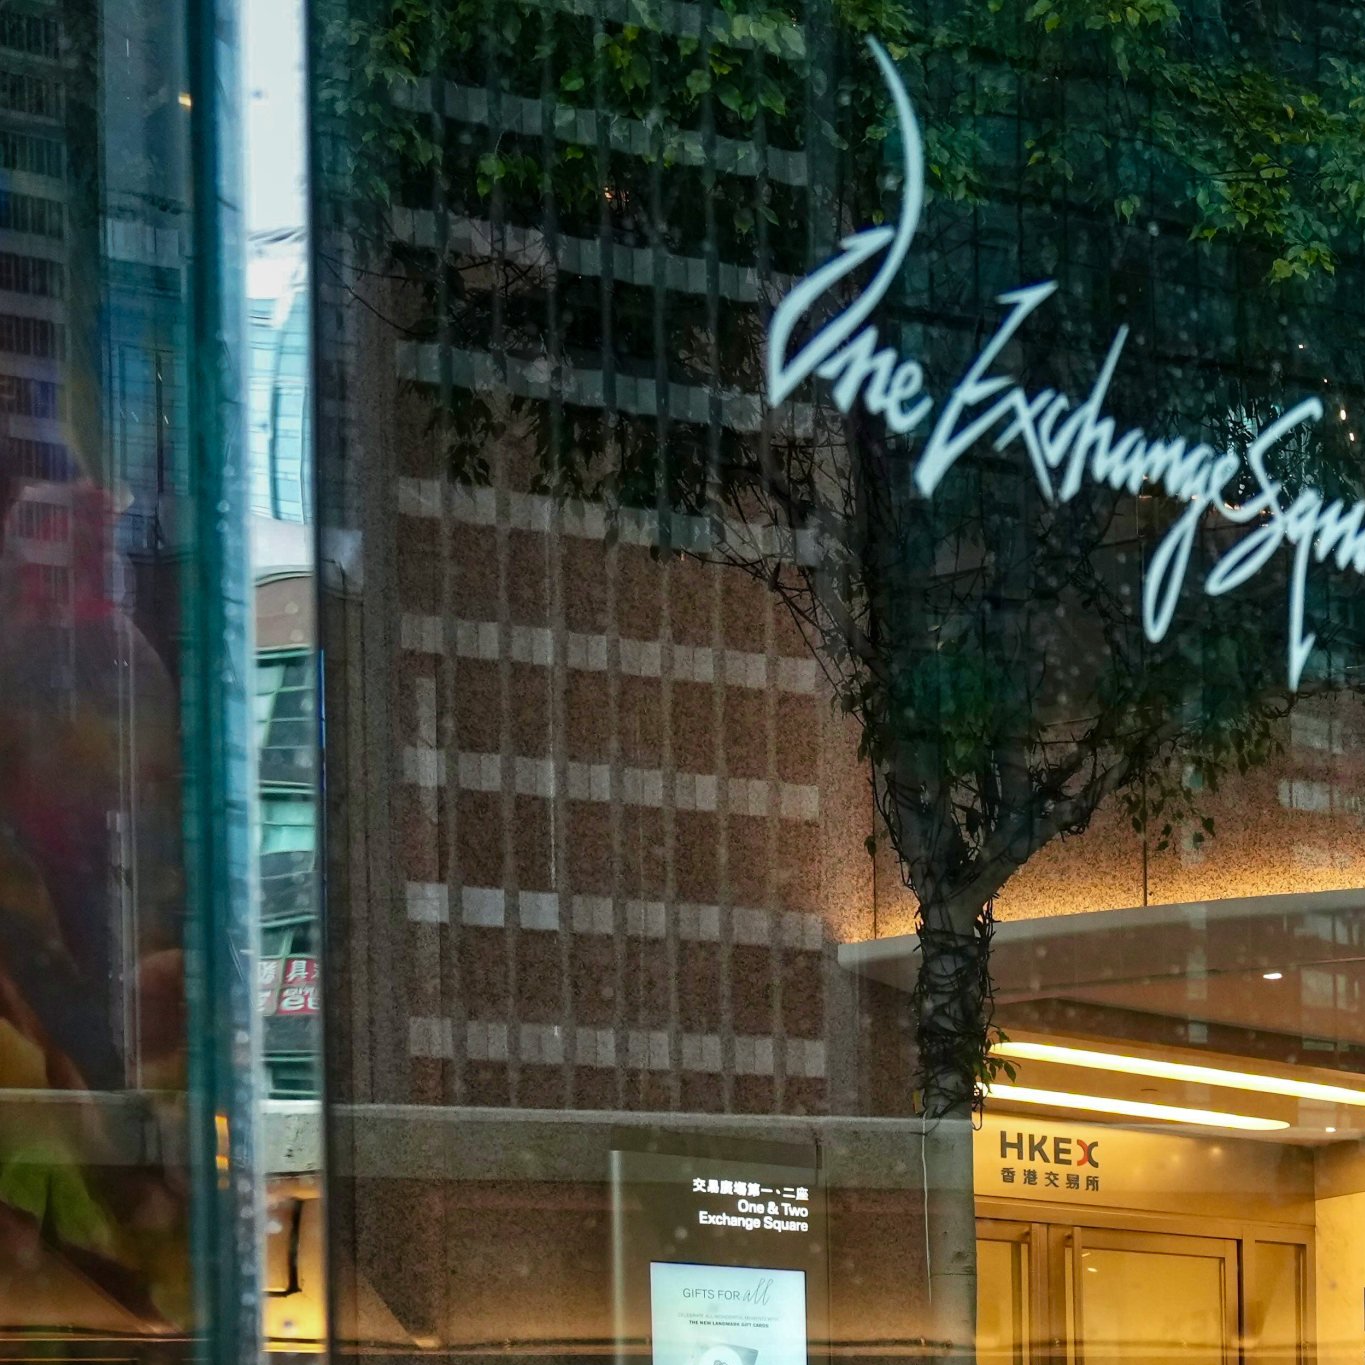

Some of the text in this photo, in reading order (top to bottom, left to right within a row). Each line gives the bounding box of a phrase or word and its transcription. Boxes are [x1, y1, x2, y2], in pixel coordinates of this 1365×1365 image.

[768, 34, 933, 433] One
[914, 279, 1268, 644] Exchange
[1000, 1130, 1099, 1169] HKEX
[1001, 1167, 1099, 1192] 香港交易所
[737, 1198, 809, 1218] One & Two
[698, 1210, 809, 1233] Exchange Square
[682, 1287, 715, 1300] GIFTS
[717, 1289, 740, 1301] FOR
